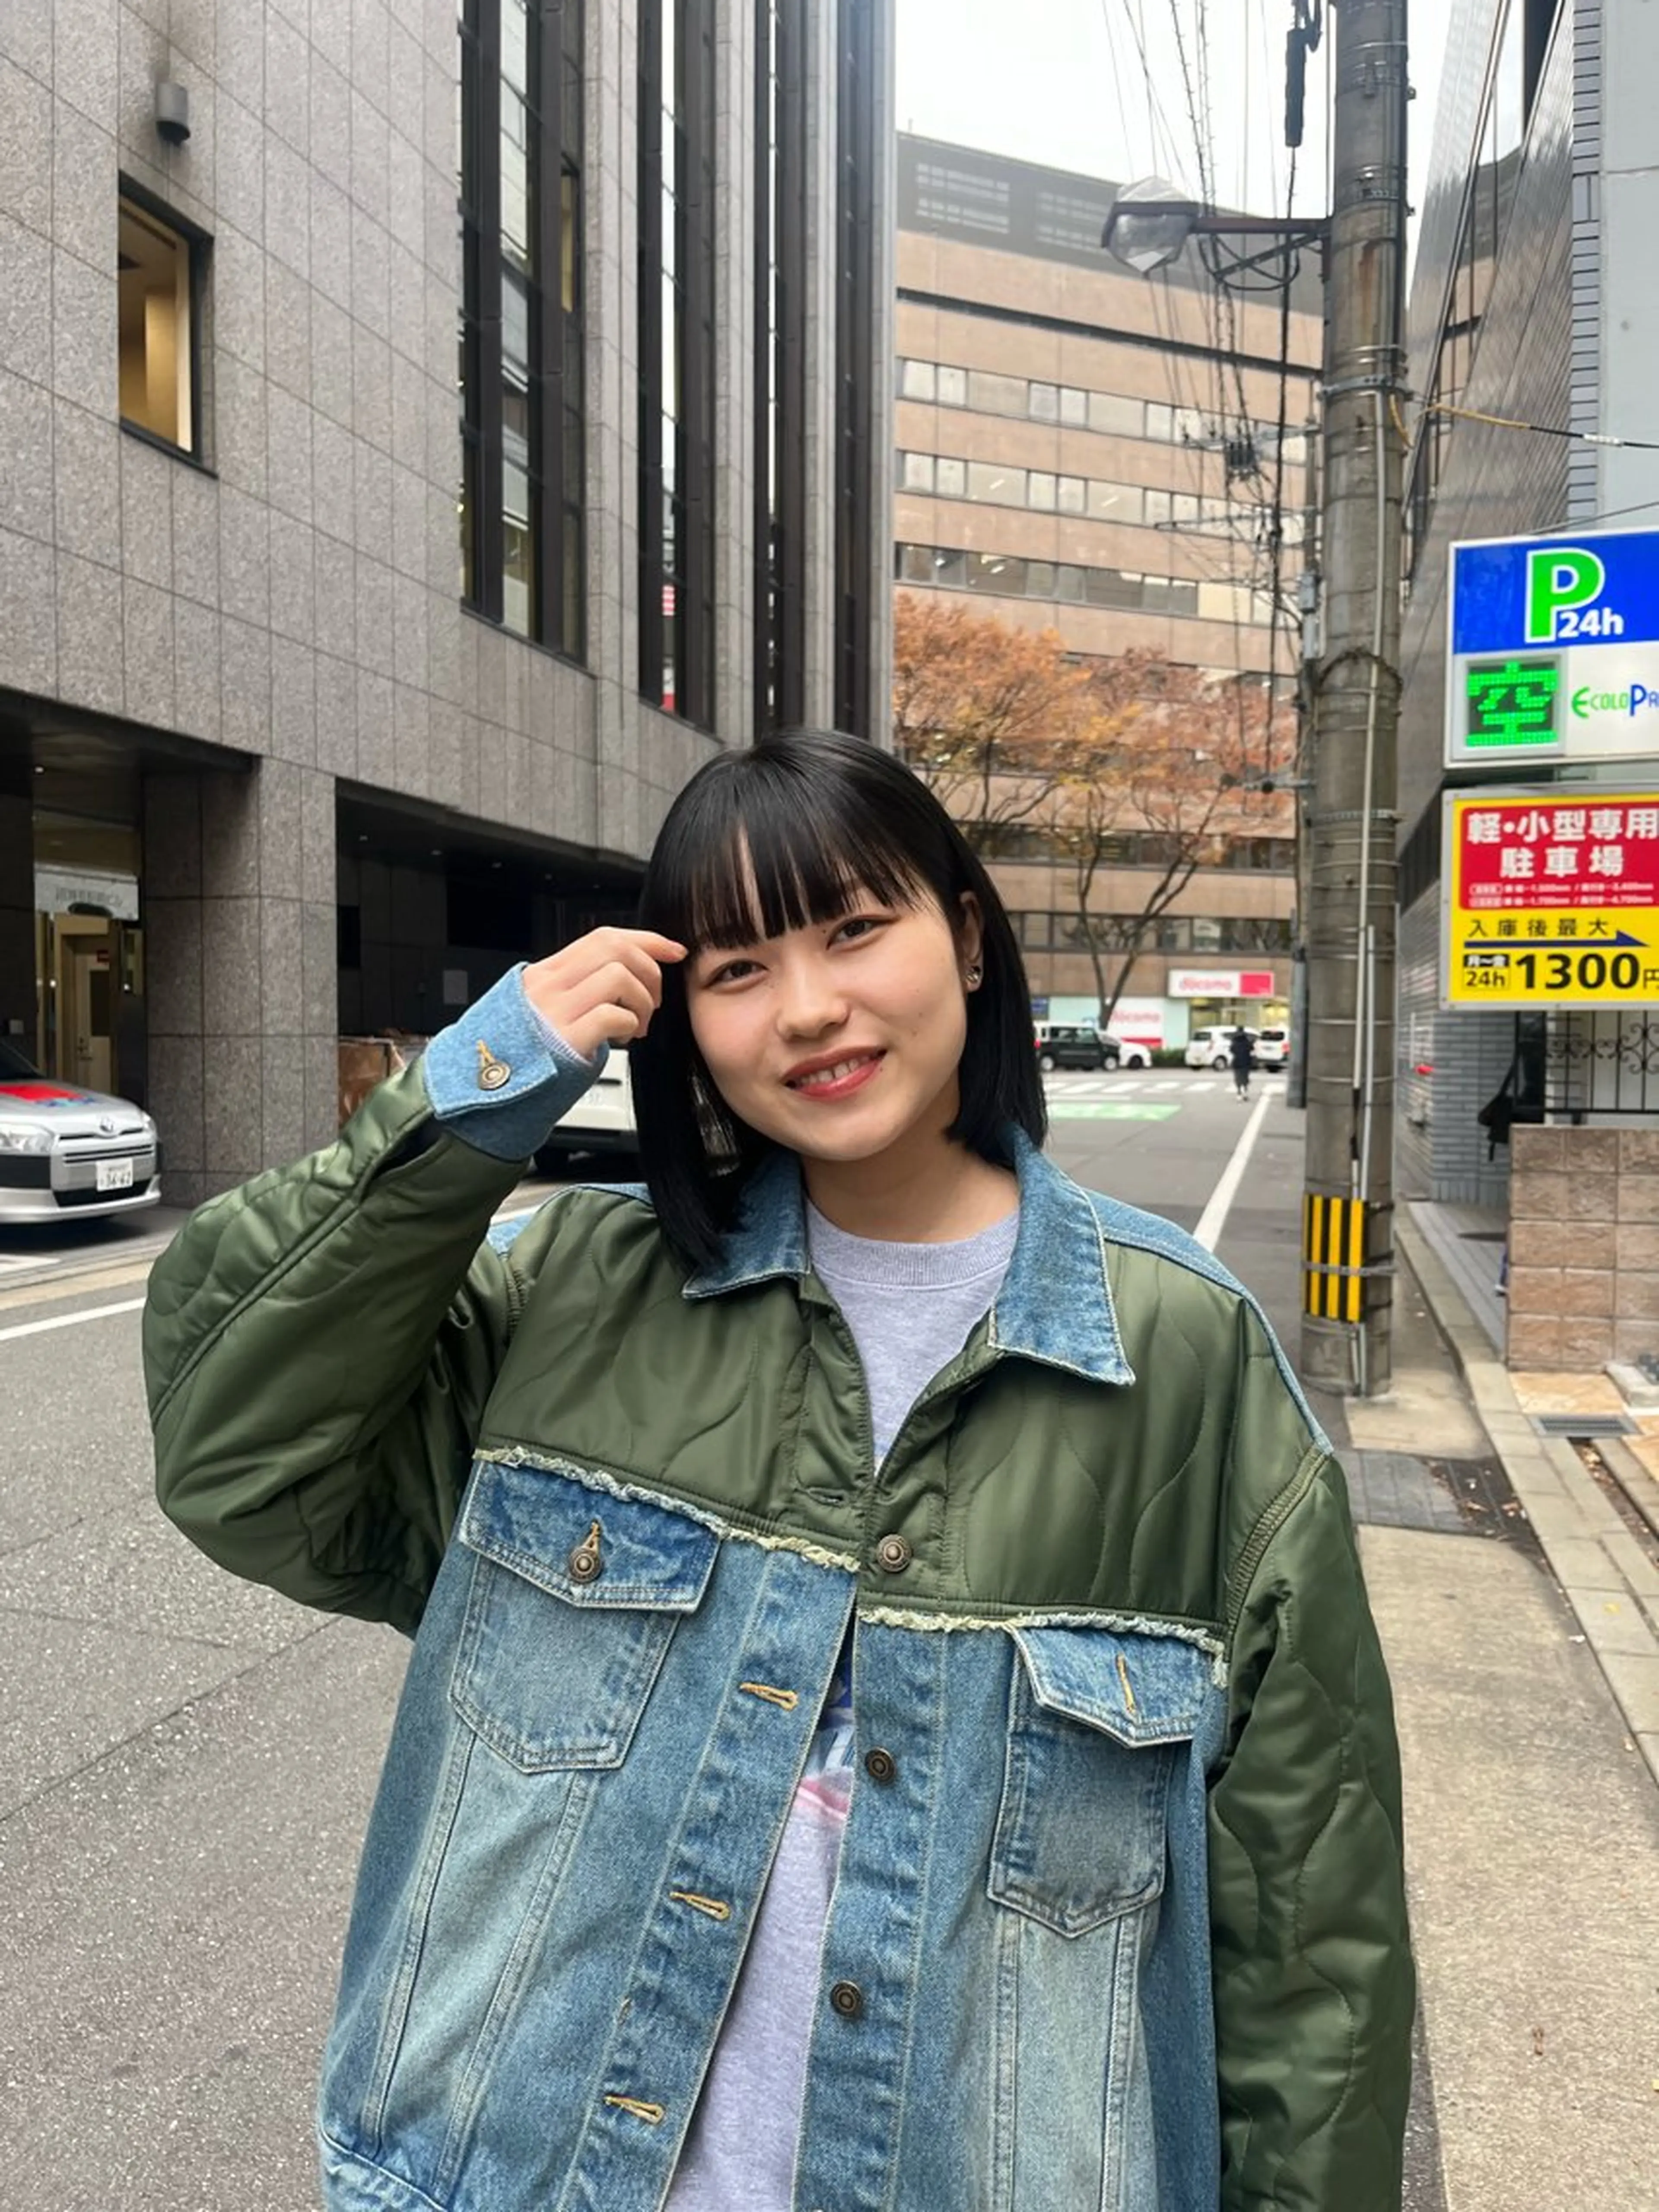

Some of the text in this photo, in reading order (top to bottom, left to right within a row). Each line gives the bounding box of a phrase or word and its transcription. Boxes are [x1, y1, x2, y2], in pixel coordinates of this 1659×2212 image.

[1525, 548, 1624, 643] P 24h
[1466, 660, 1558, 747] 空
[1500, 845, 1624, 878] 駐車場
[1469, 918, 1608, 937] 入庫後最大
[1466, 970, 1506, 987] 24h
